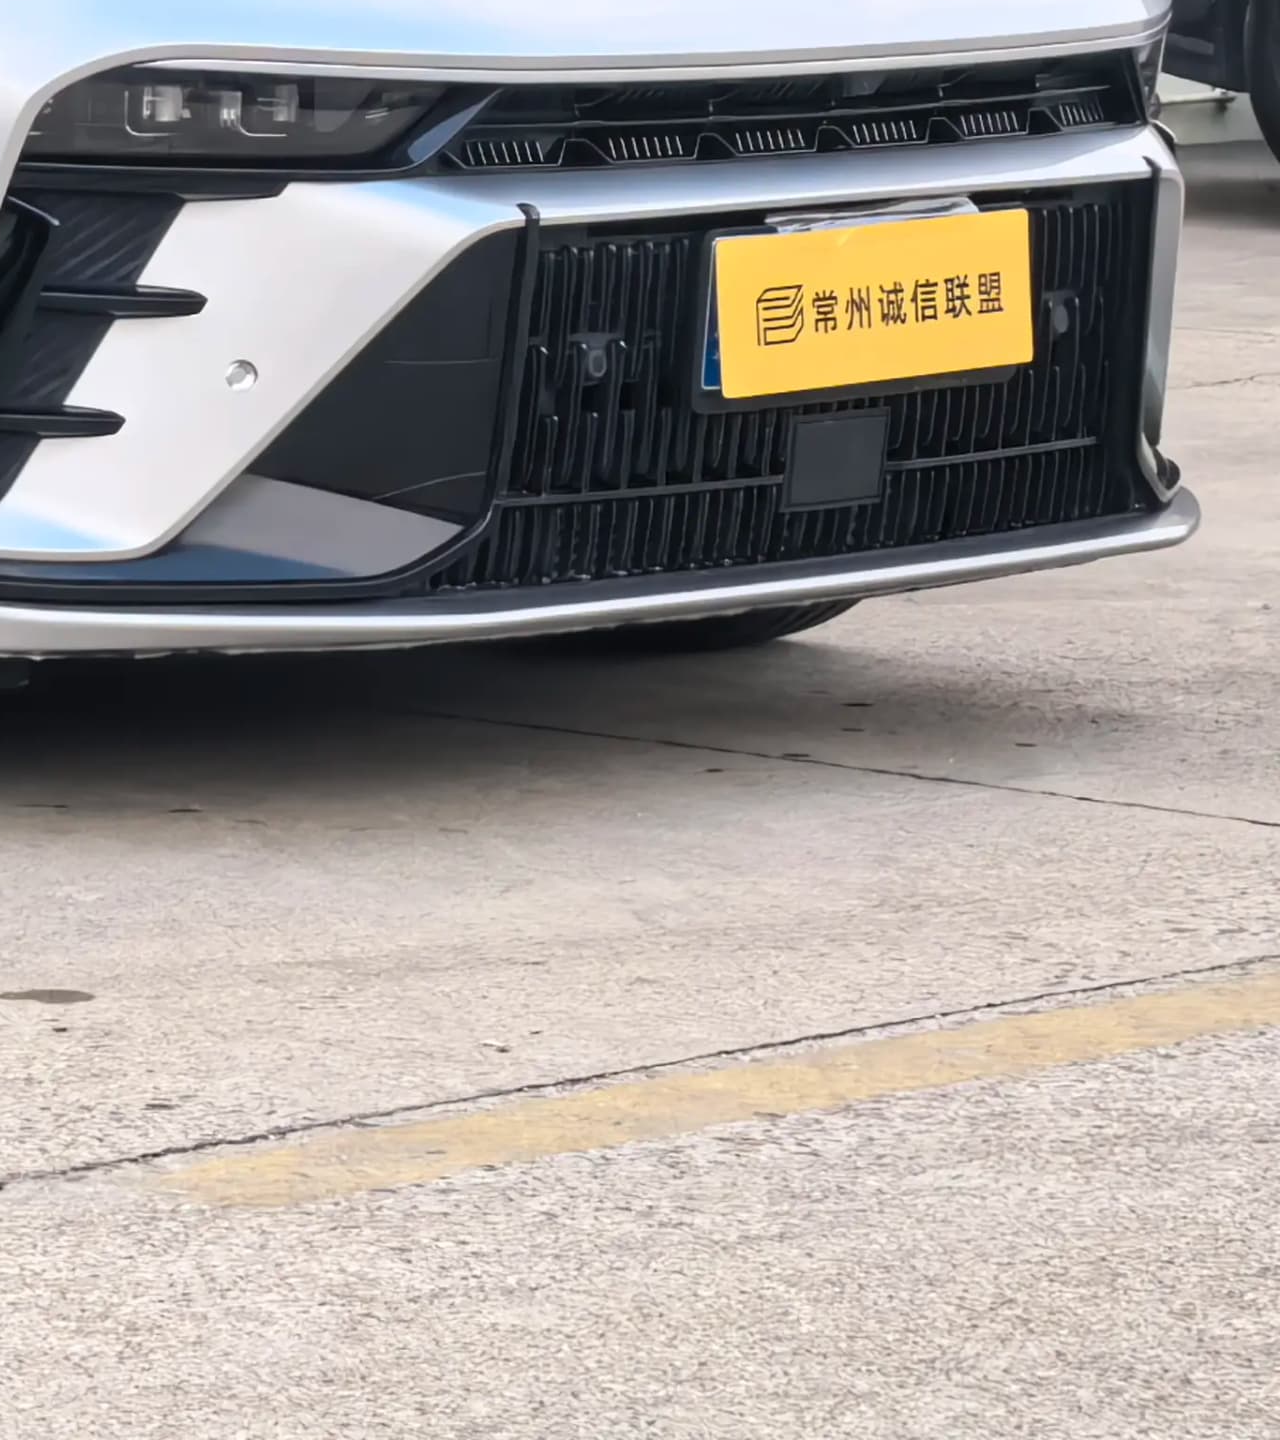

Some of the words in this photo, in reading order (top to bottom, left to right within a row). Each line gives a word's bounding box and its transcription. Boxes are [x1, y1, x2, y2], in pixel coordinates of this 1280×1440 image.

[811, 271, 1005, 335] 常州诚信联盟
